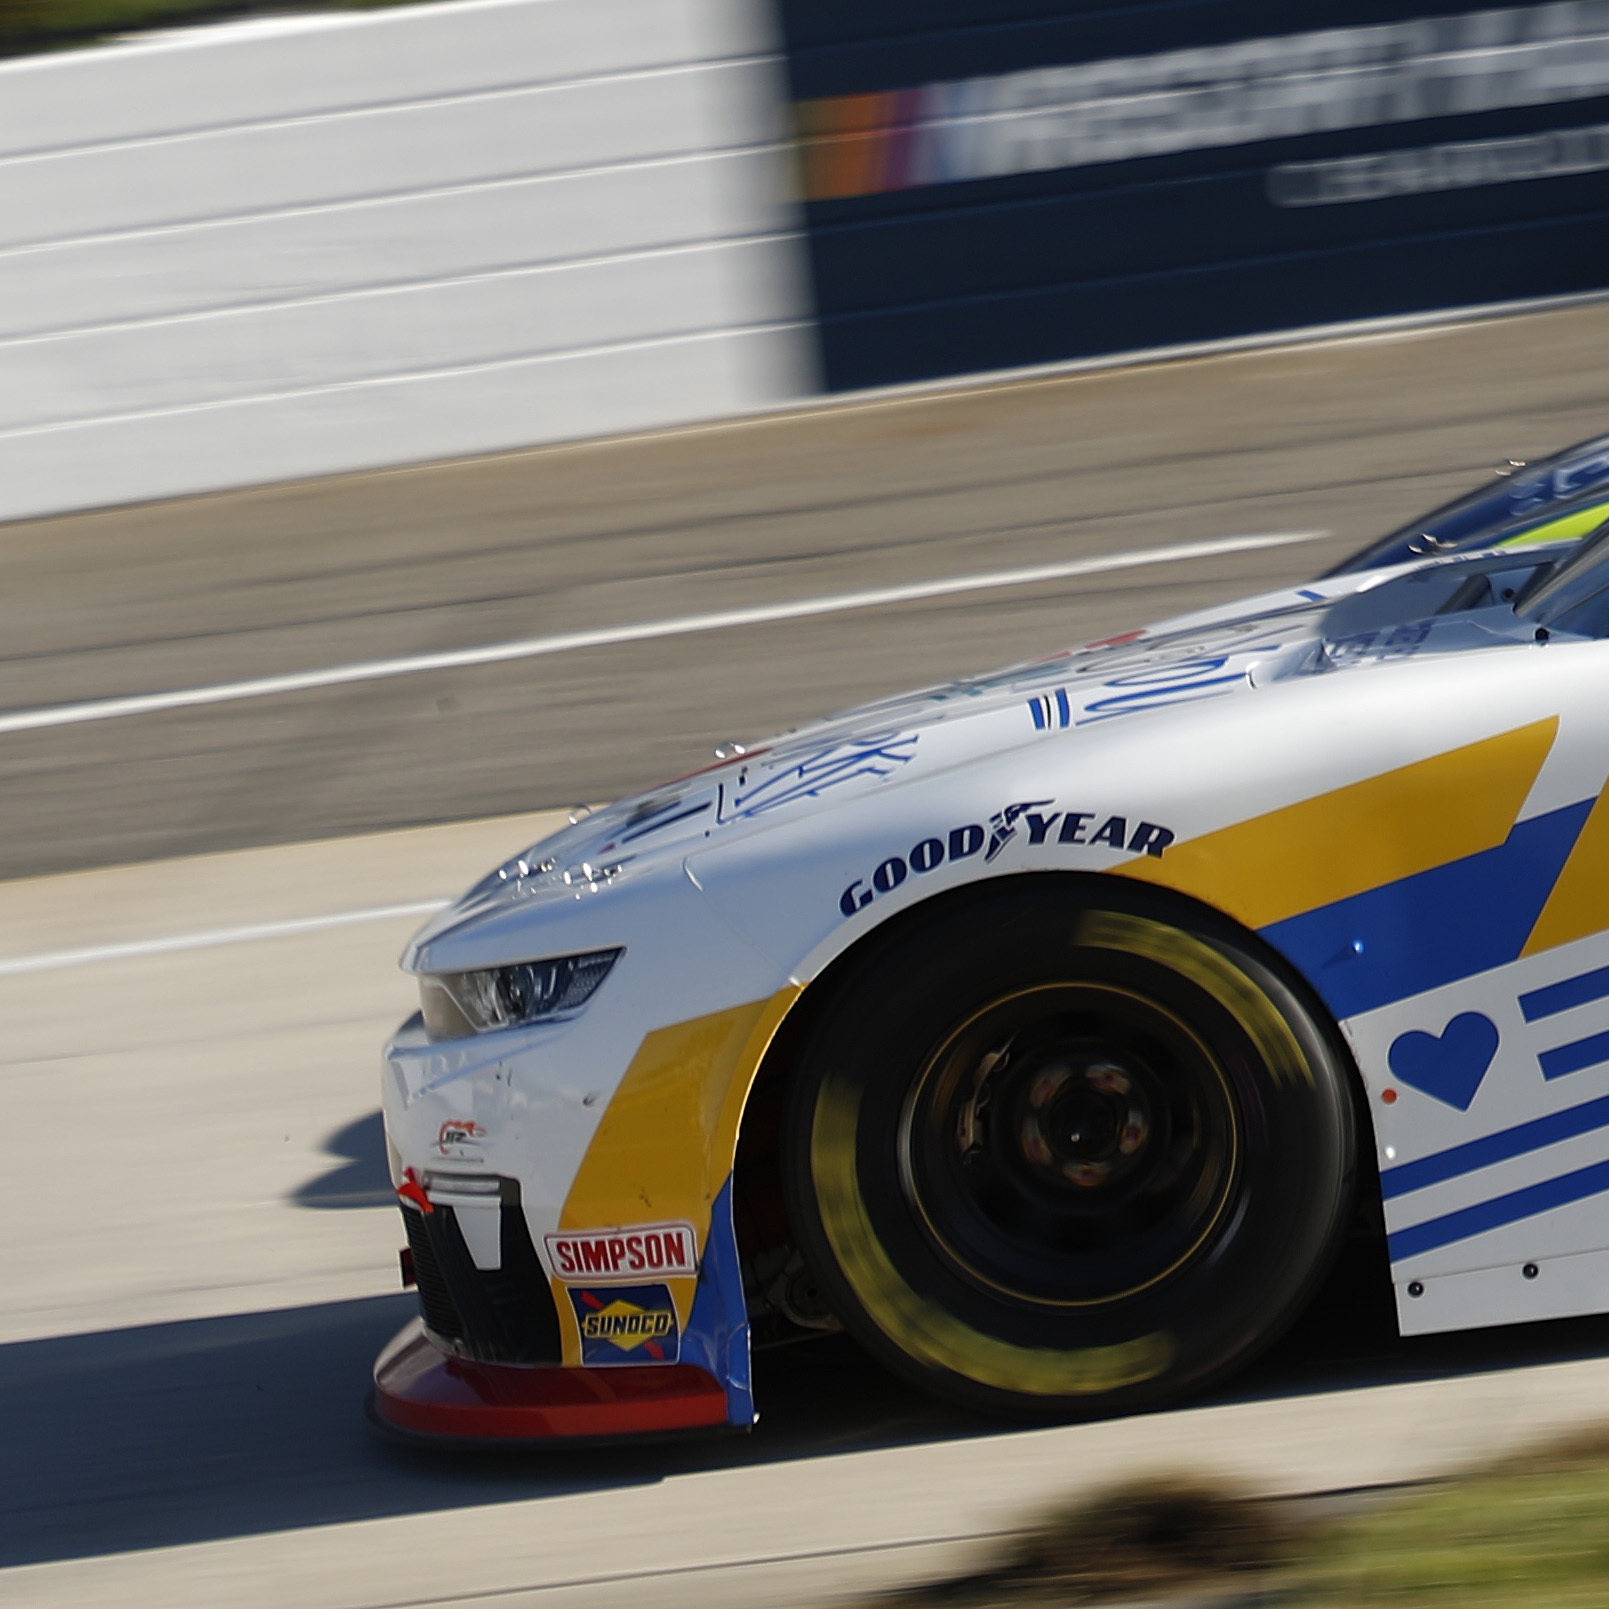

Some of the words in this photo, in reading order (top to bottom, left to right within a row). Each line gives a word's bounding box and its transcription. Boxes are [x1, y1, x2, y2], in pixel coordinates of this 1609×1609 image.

[839, 799, 1178, 919] GOODYEAR
[555, 1232, 688, 1274] SIMPSON
[583, 1313, 673, 1338] SUNOCO
